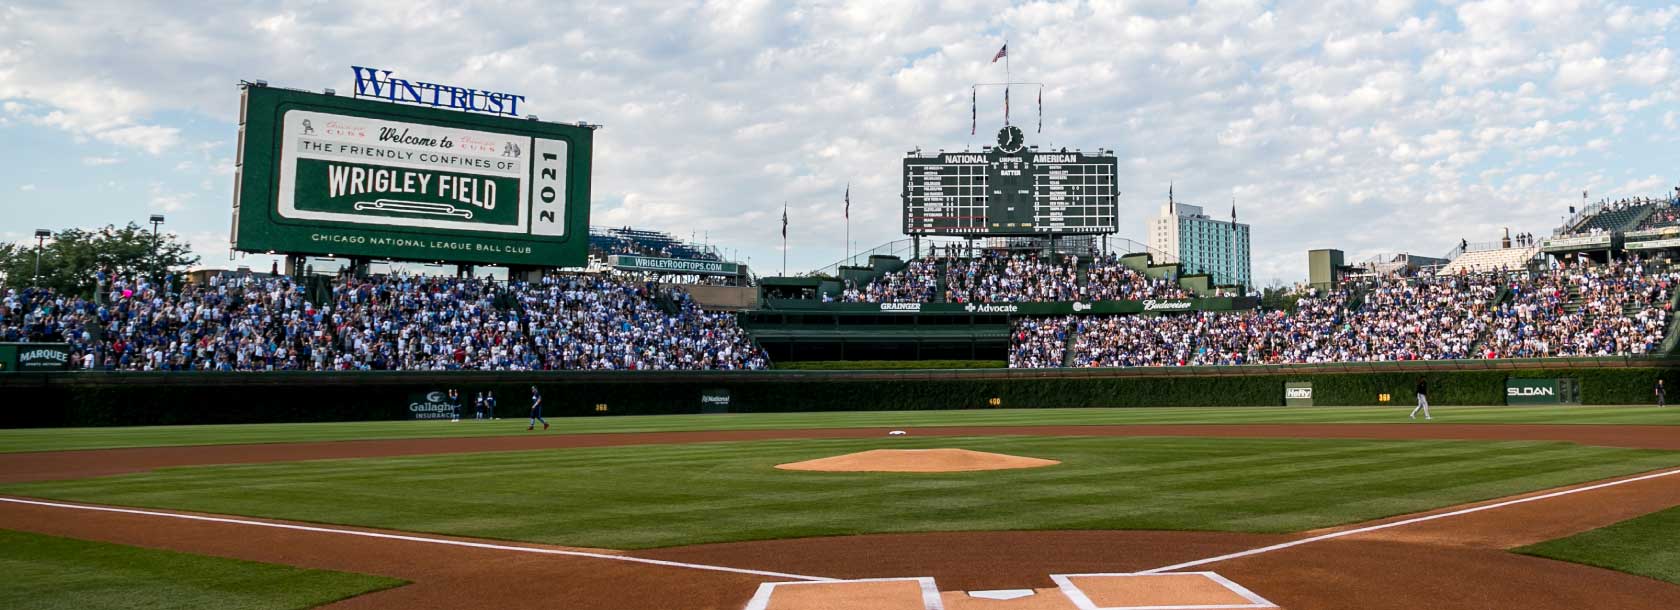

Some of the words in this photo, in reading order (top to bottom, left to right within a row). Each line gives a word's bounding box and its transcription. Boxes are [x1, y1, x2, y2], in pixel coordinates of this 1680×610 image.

[351, 66, 525, 116] WINTRUST
[379, 127, 437, 147] Welcome
[440, 136, 453, 148] to
[303, 140, 332, 152] THE
[340, 145, 413, 160] FRIENDLY
[419, 153, 491, 168] CONFINES
[497, 162, 514, 170] OF
[945, 154, 989, 164] NATIONAL
[1033, 154, 1077, 163] AMERICAN
[329, 164, 431, 198] WRIGLEY
[438, 175, 497, 210] FIELD
[540, 153, 557, 223] 2021
[311, 233, 365, 244] CHICAGO
[370, 238, 426, 247] NATIONAL
[430, 241, 472, 250] LEAGUE
[476, 243, 501, 252] BALL
[505, 245, 532, 254] CLUB
[880, 302, 921, 310] GRAINGER
[977, 303, 1018, 313] Advocate
[1142, 300, 1192, 310] Budweiser
[20, 349, 68, 362] MARQUEE
[989, 397, 1000, 405] 400
[410, 402, 454, 413] Gallagh
